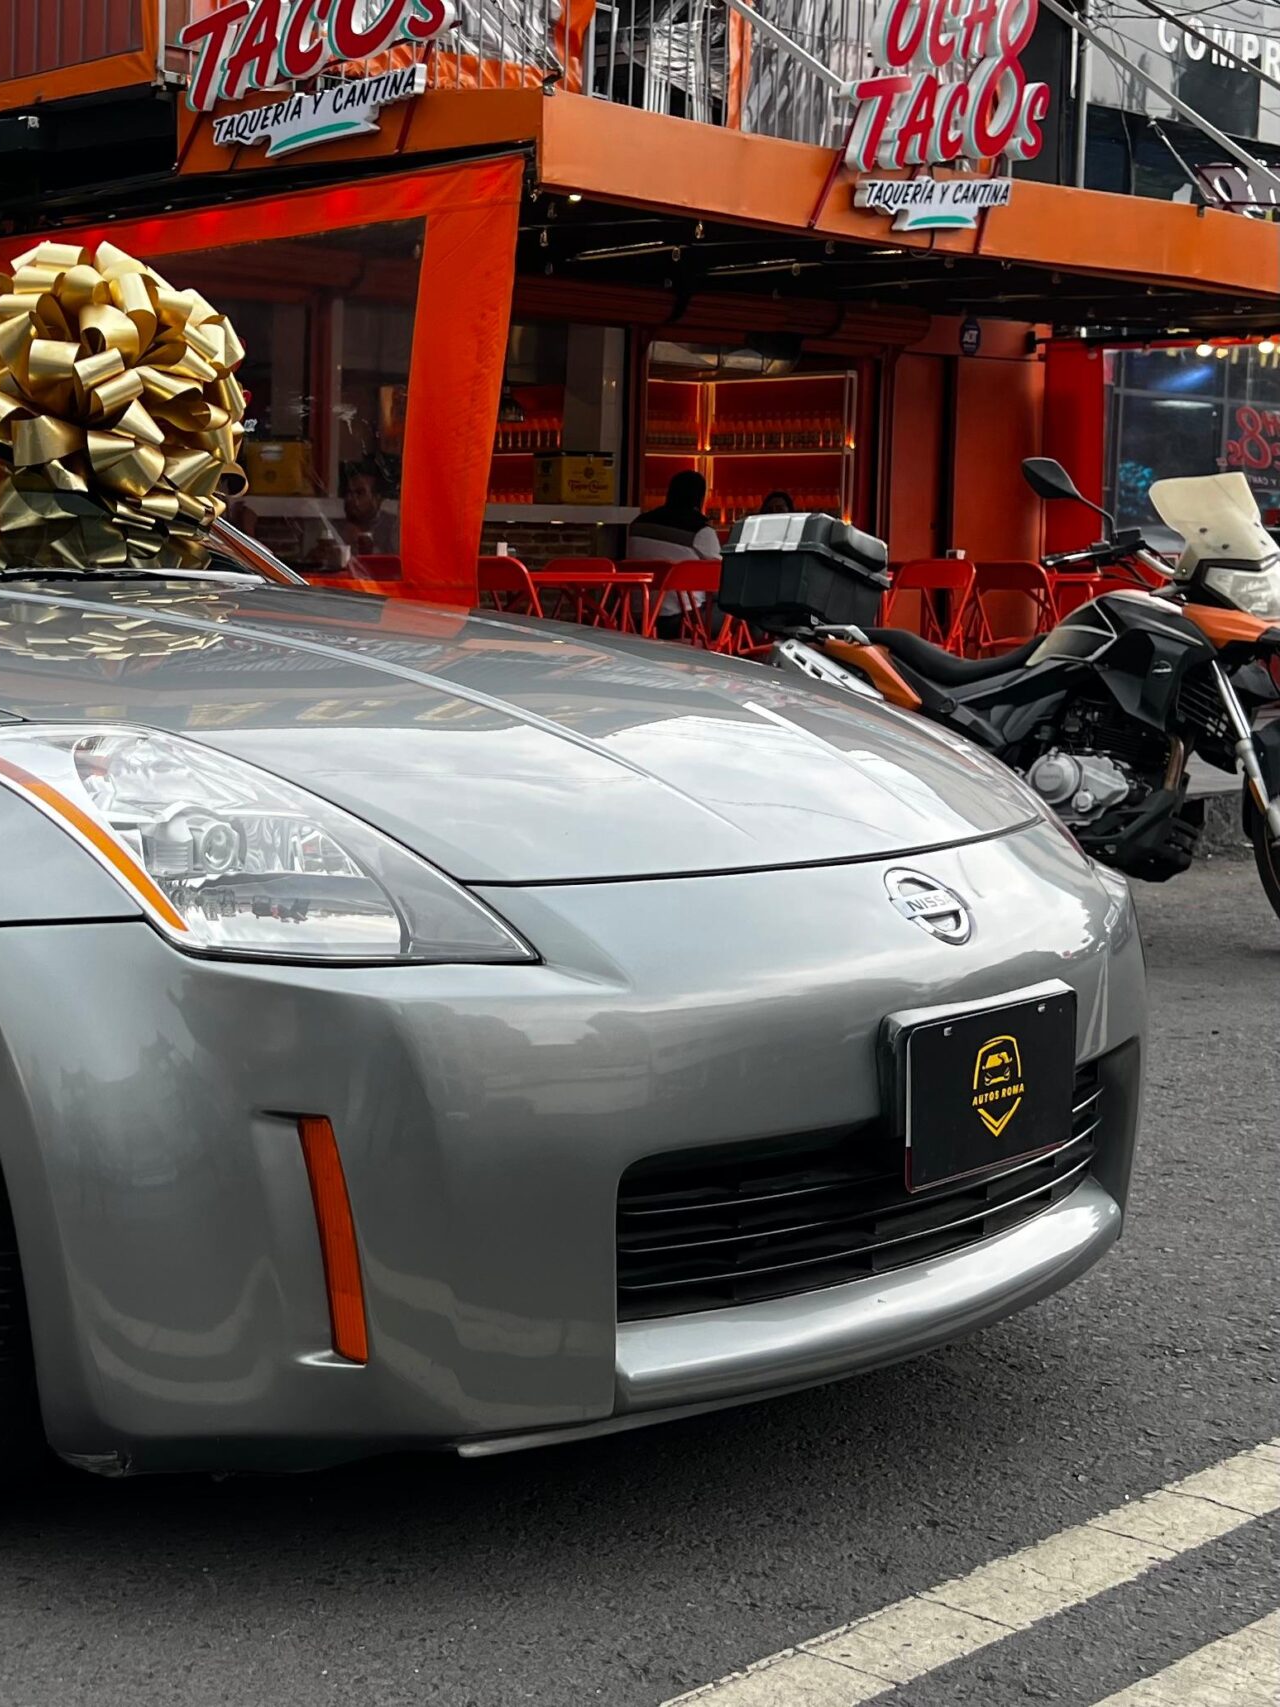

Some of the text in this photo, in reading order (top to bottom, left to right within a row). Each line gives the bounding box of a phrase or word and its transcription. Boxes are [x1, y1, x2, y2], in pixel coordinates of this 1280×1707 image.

[177, 0, 454, 111] TACOS
[215, 67, 417, 143] TAQUERÍA Y CANTINA
[848, 68, 1050, 171] TACOS
[867, 180, 1011, 210] TAQUERÍA Y CANTINA
[972, 1083, 1025, 1107] AUTOS ROMA
